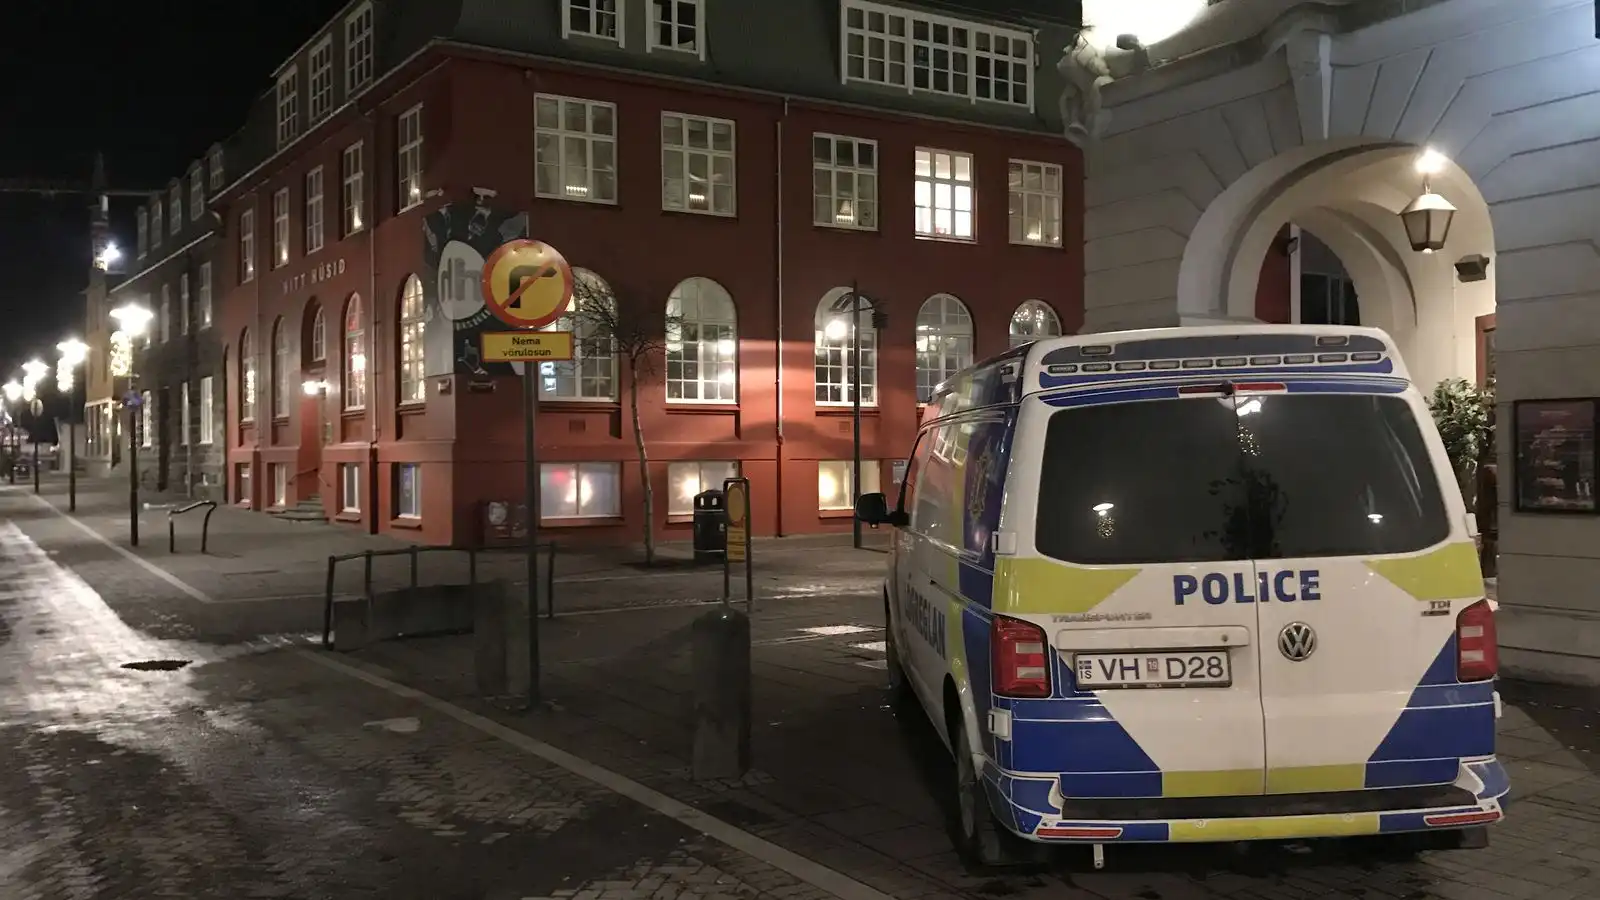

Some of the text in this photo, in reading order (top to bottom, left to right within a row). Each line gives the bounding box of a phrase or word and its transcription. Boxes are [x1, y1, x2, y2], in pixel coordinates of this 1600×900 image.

[512, 336, 541, 346] Nema
[502, 347, 552, 357] vörulosun
[1173, 569, 1321, 605] POLICE
[1429, 600, 1452, 610] TDI
[1098, 655, 1225, 681] VH D28
[1078, 670, 1093, 681] IS
